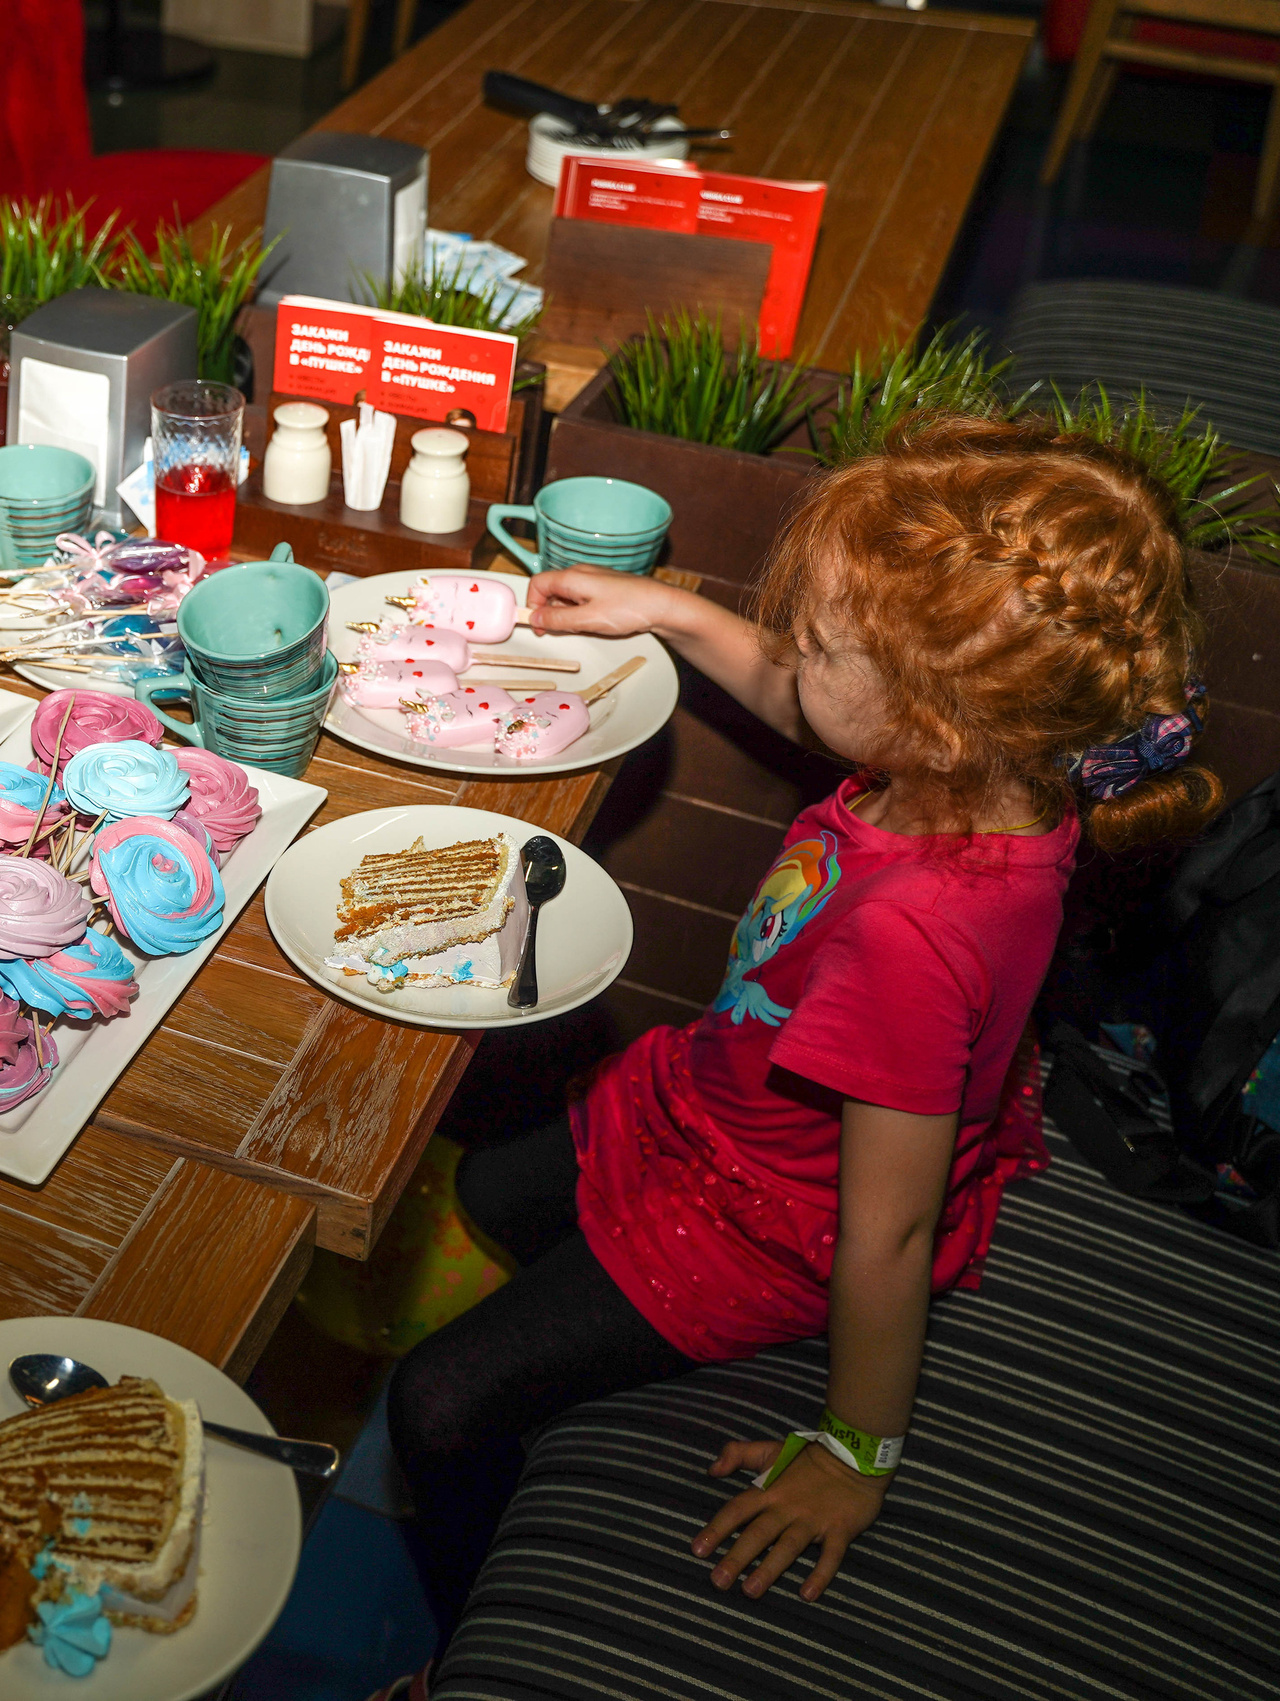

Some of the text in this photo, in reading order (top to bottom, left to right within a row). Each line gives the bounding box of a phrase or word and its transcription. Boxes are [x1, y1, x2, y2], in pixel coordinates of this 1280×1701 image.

[291, 323, 349, 342] ЗАКАЖИ
[290, 338, 327, 354] ДЕНЬ
[383, 340, 442, 361] ЗАКАЖИ
[289, 353, 363, 374] В «ПУШКЕ»
[381, 355, 496, 386] ДЕНЬ РОЖДЕНИЯ
[381, 370, 456, 394] В «ПУШКЕ»
